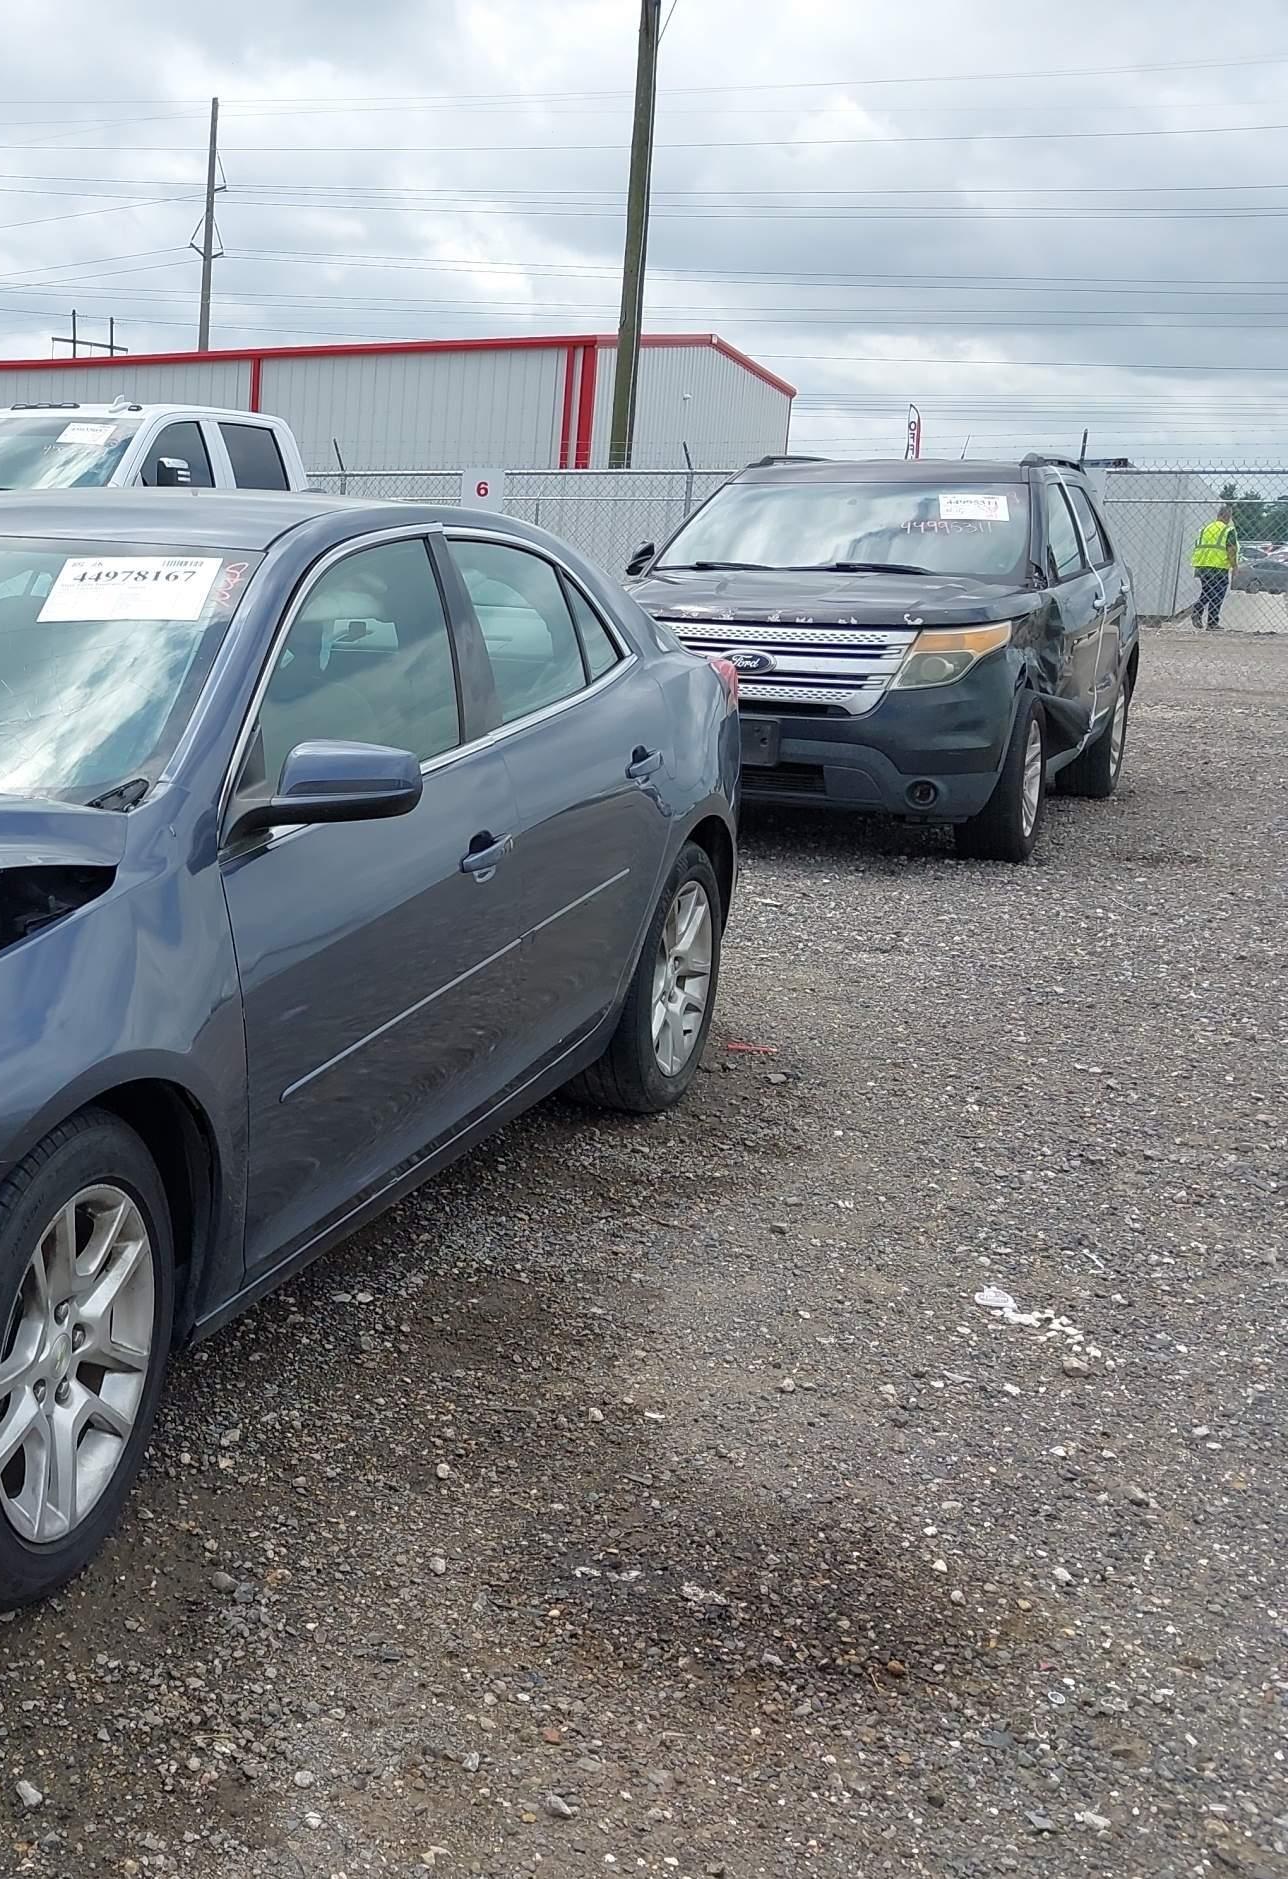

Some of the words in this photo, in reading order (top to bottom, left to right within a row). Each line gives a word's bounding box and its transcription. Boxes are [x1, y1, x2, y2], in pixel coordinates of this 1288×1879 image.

[476, 481, 489, 498] 6
[900, 520, 992, 535] 44995311
[73, 569, 197, 582] 44978167
[732, 654, 761, 668] Ford
